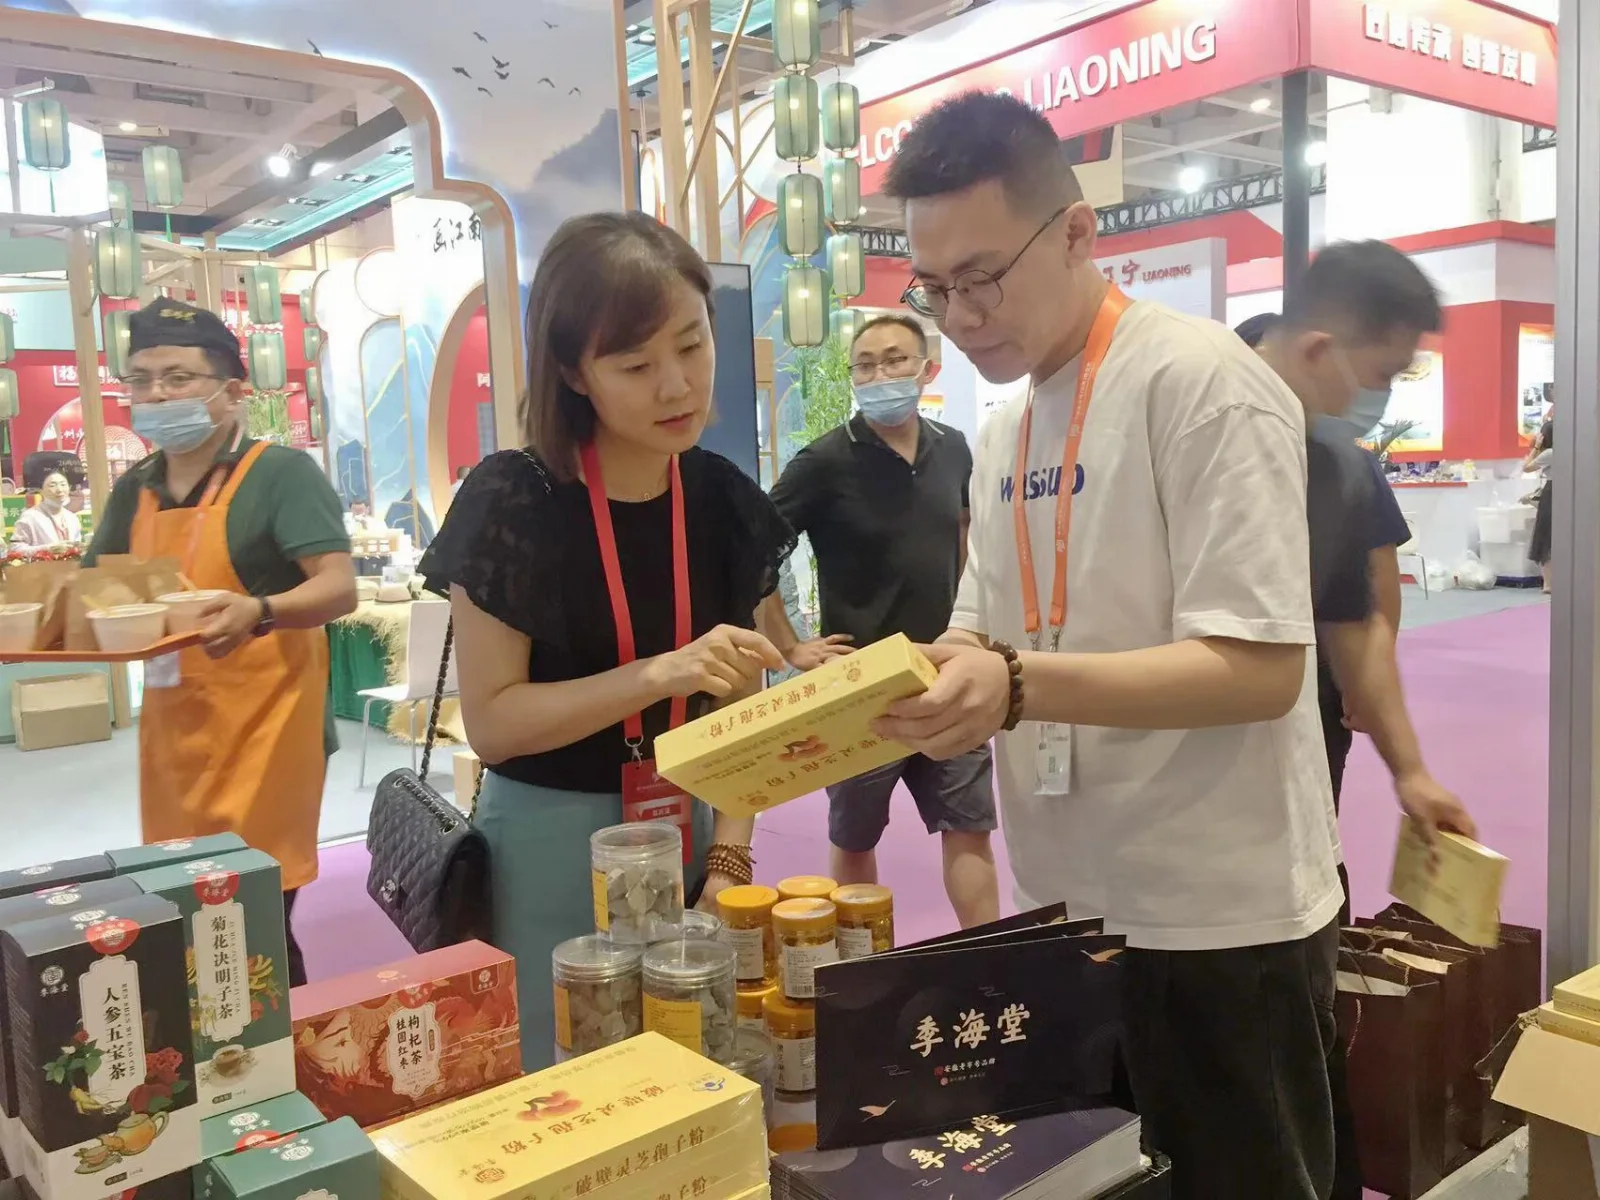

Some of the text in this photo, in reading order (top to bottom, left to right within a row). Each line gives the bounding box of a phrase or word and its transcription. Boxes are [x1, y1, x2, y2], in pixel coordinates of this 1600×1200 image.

[1023, 19, 1217, 112] LIAONING
[1142, 264, 1192, 284] LIAONING
[211, 916, 233, 1020] 菊花决明子茶
[103, 987, 126, 1081] 人参五宝茶
[396, 1018, 409, 1070] 桂圆红枣
[408, 1015, 422, 1065] 枸杞茶
[910, 1003, 1031, 1058] 季海堂
[501, 1084, 665, 1155] 破壁灵芝孢子粉
[909, 1114, 1018, 1171] 季海堂
[575, 1125, 706, 1197] 破壁灵芝孢子粉
